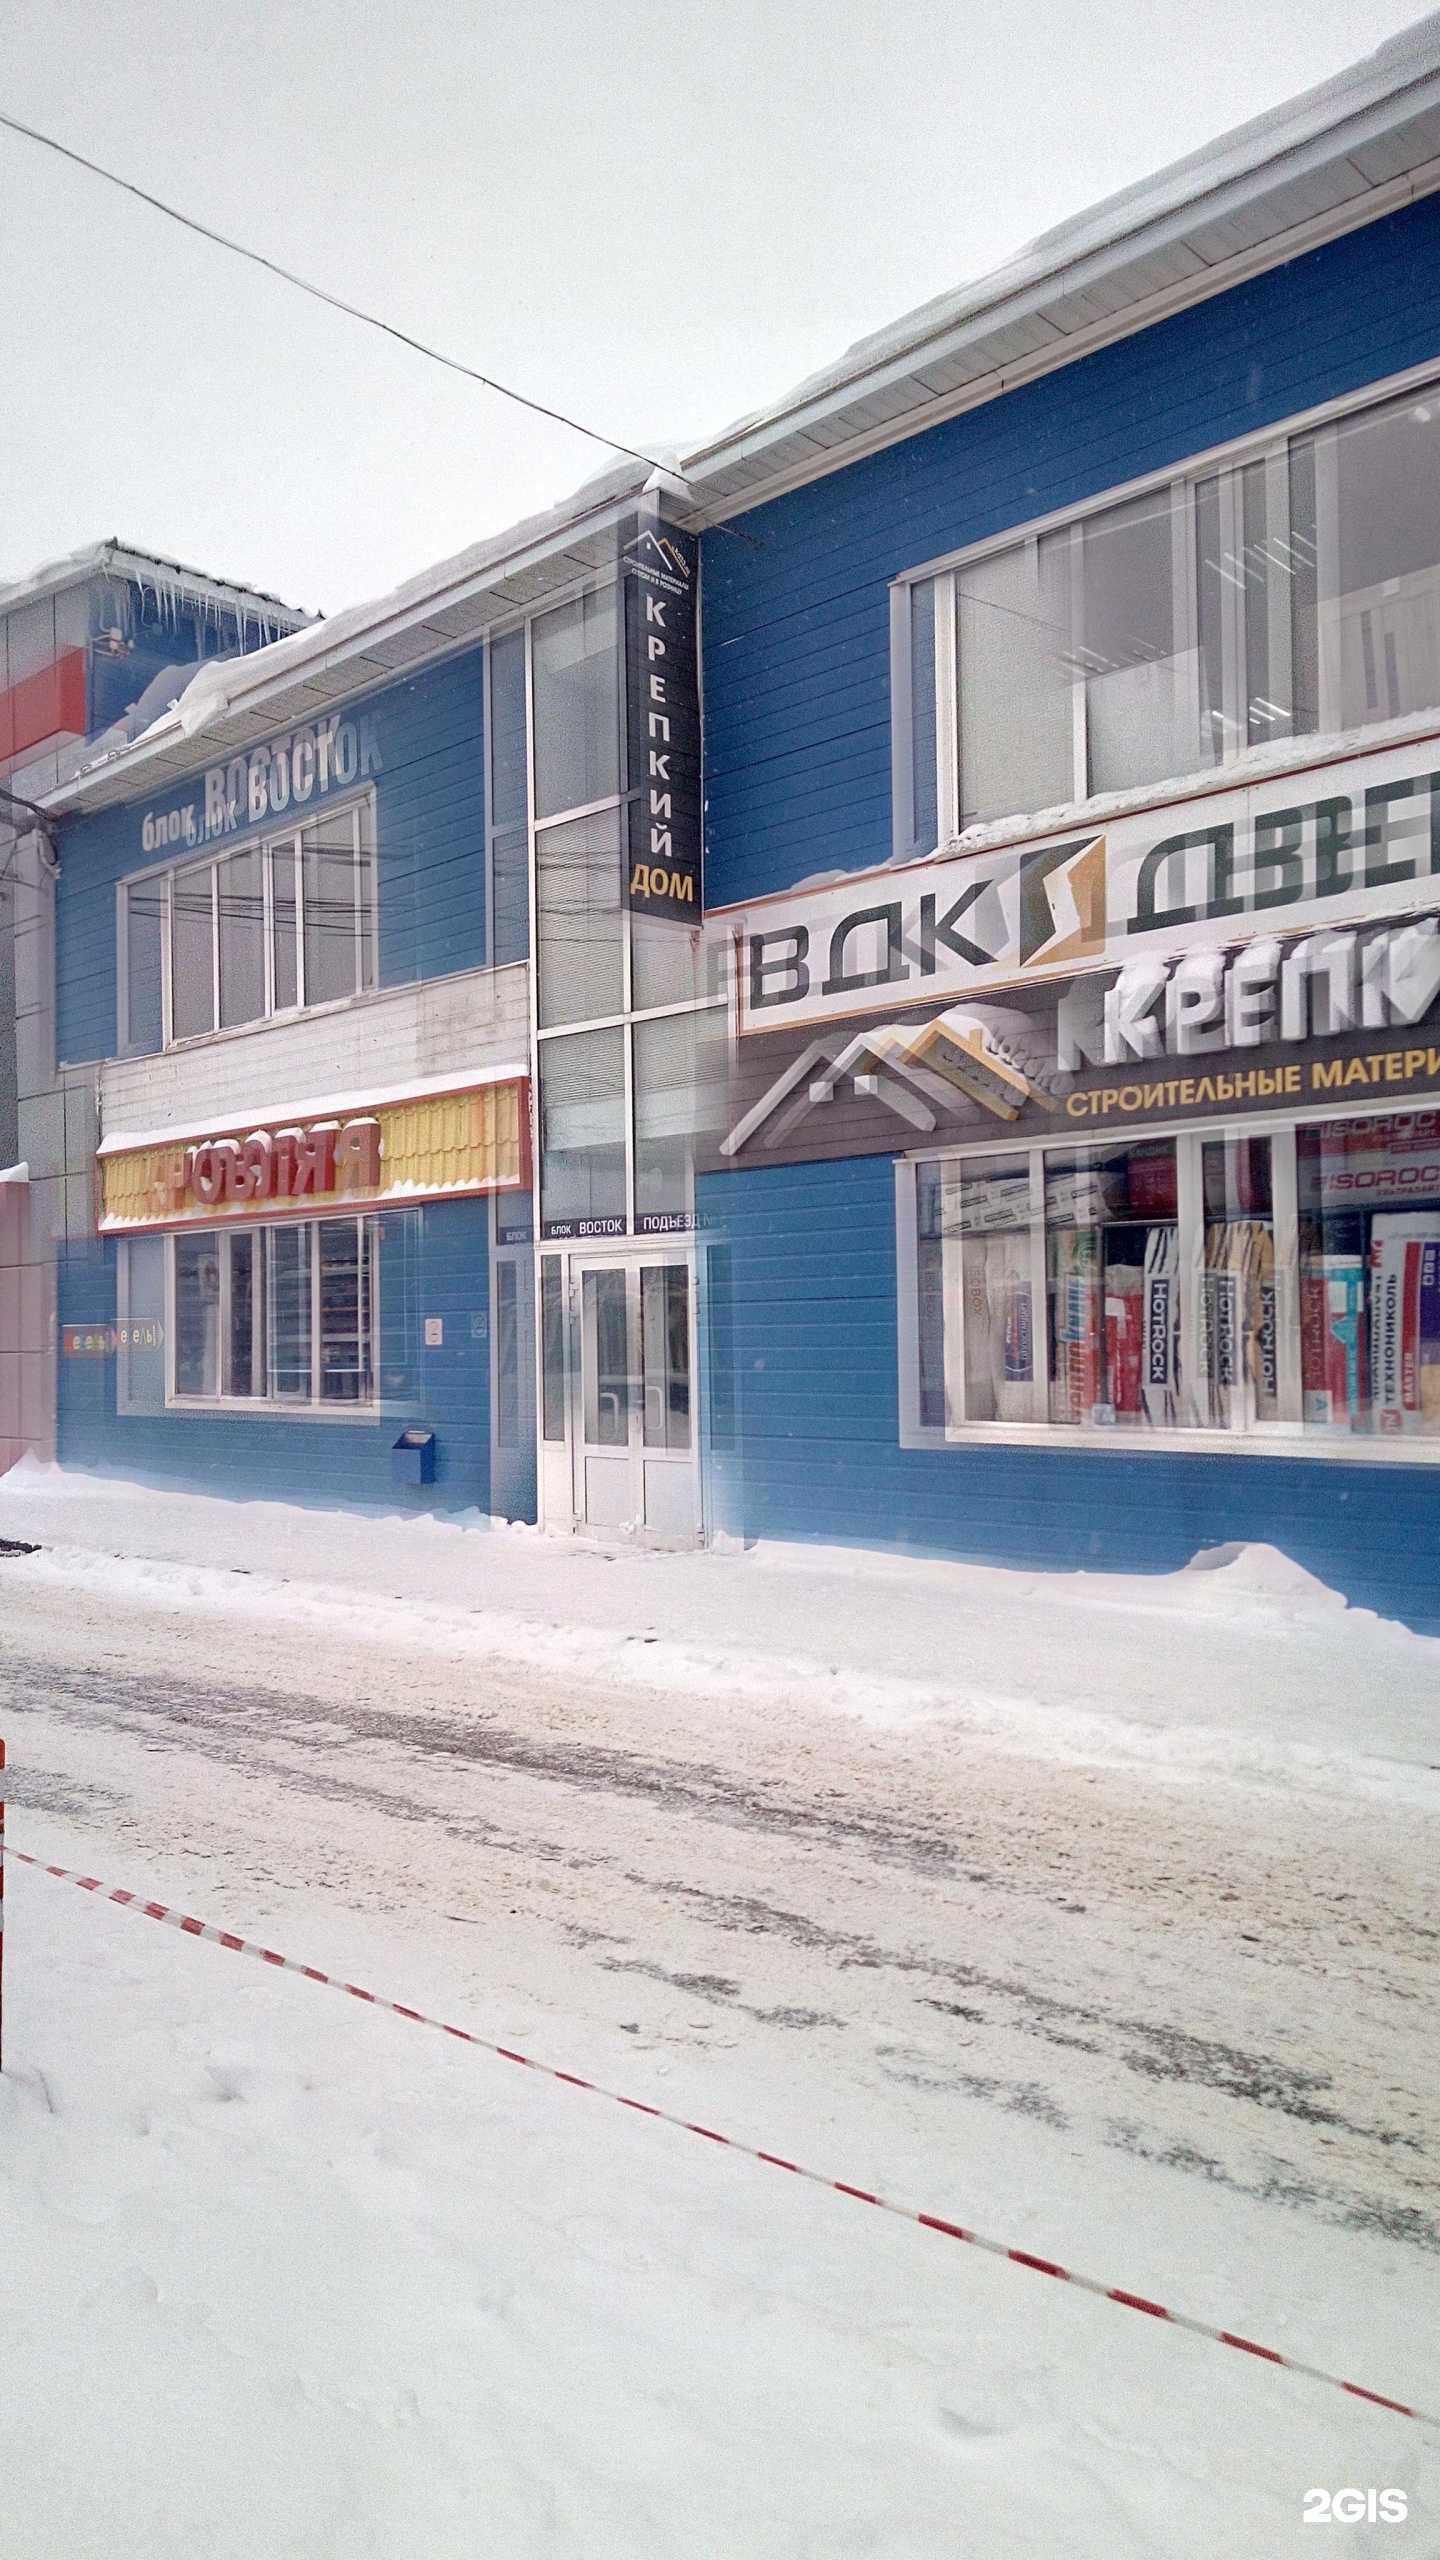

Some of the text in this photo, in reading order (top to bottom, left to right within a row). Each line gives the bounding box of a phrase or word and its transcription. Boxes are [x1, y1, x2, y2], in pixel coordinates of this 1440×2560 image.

[248, 714, 384, 823] ВОСТОК
[646, 593, 672, 857] КРЕПКИЙ
[630, 864, 693, 902] ДОМ
[1127, 770, 1440, 934] ДВЕ
[750, 879, 999, 1010] ВДК
[1066, 1064, 1301, 1118] СТРОИТЕЛЬНЫЕ
[551, 1224, 572, 1236] БЛОК
[579, 1218, 623, 1235] ВОСТОК
[643, 1215, 699, 1231] ПОДЪЕЗД
[1384, 1273, 1398, 1404] ТЕХНОНИКОЛЬ
